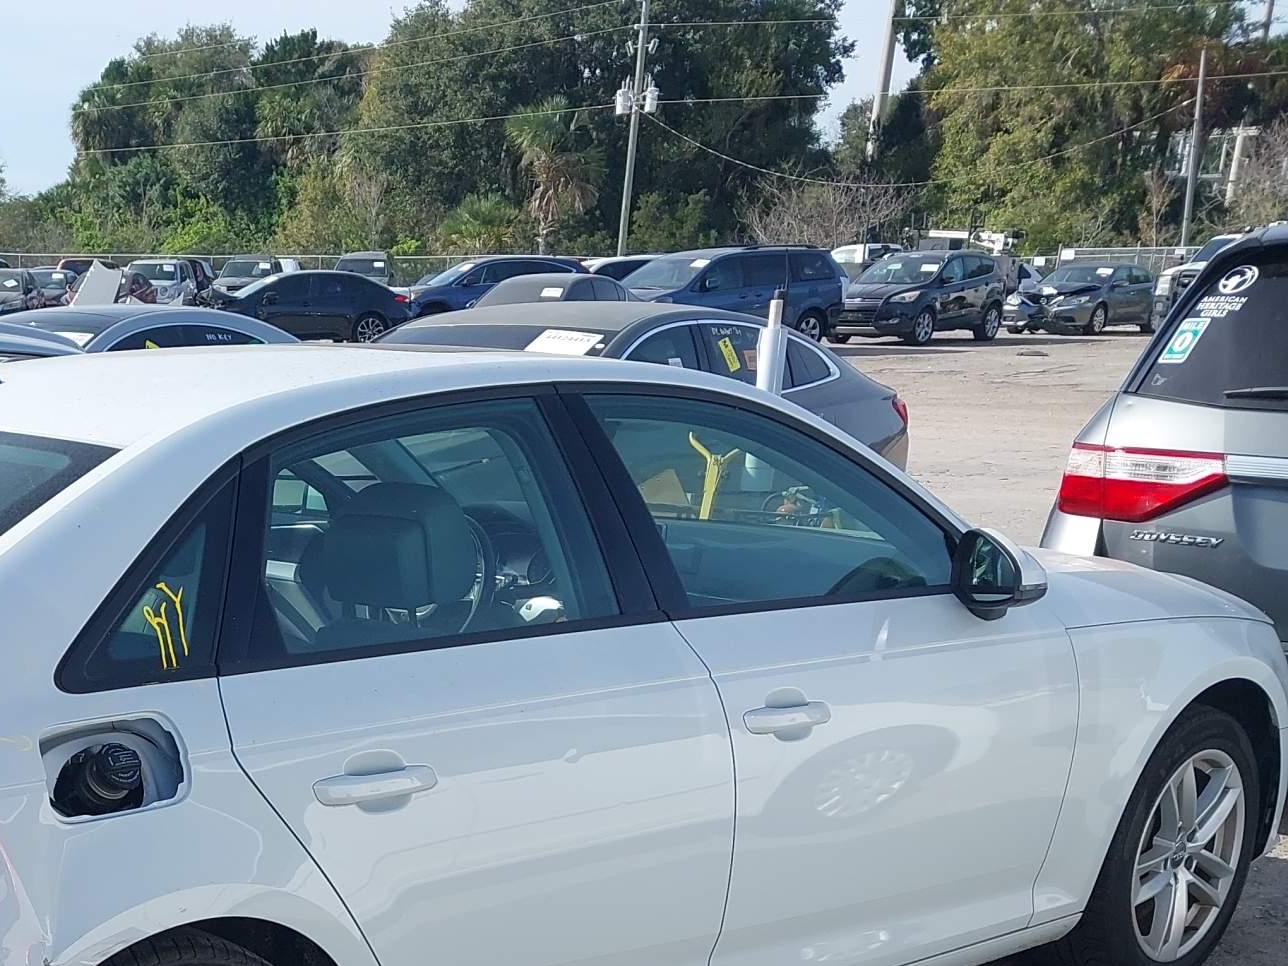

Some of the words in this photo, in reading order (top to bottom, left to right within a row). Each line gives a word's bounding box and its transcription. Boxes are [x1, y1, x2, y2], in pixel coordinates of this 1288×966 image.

[1196, 302, 1243, 310] HERITAGE
[1182, 321, 1204, 329] MILE
[1129, 529, 1225, 548] ODYSSEY
